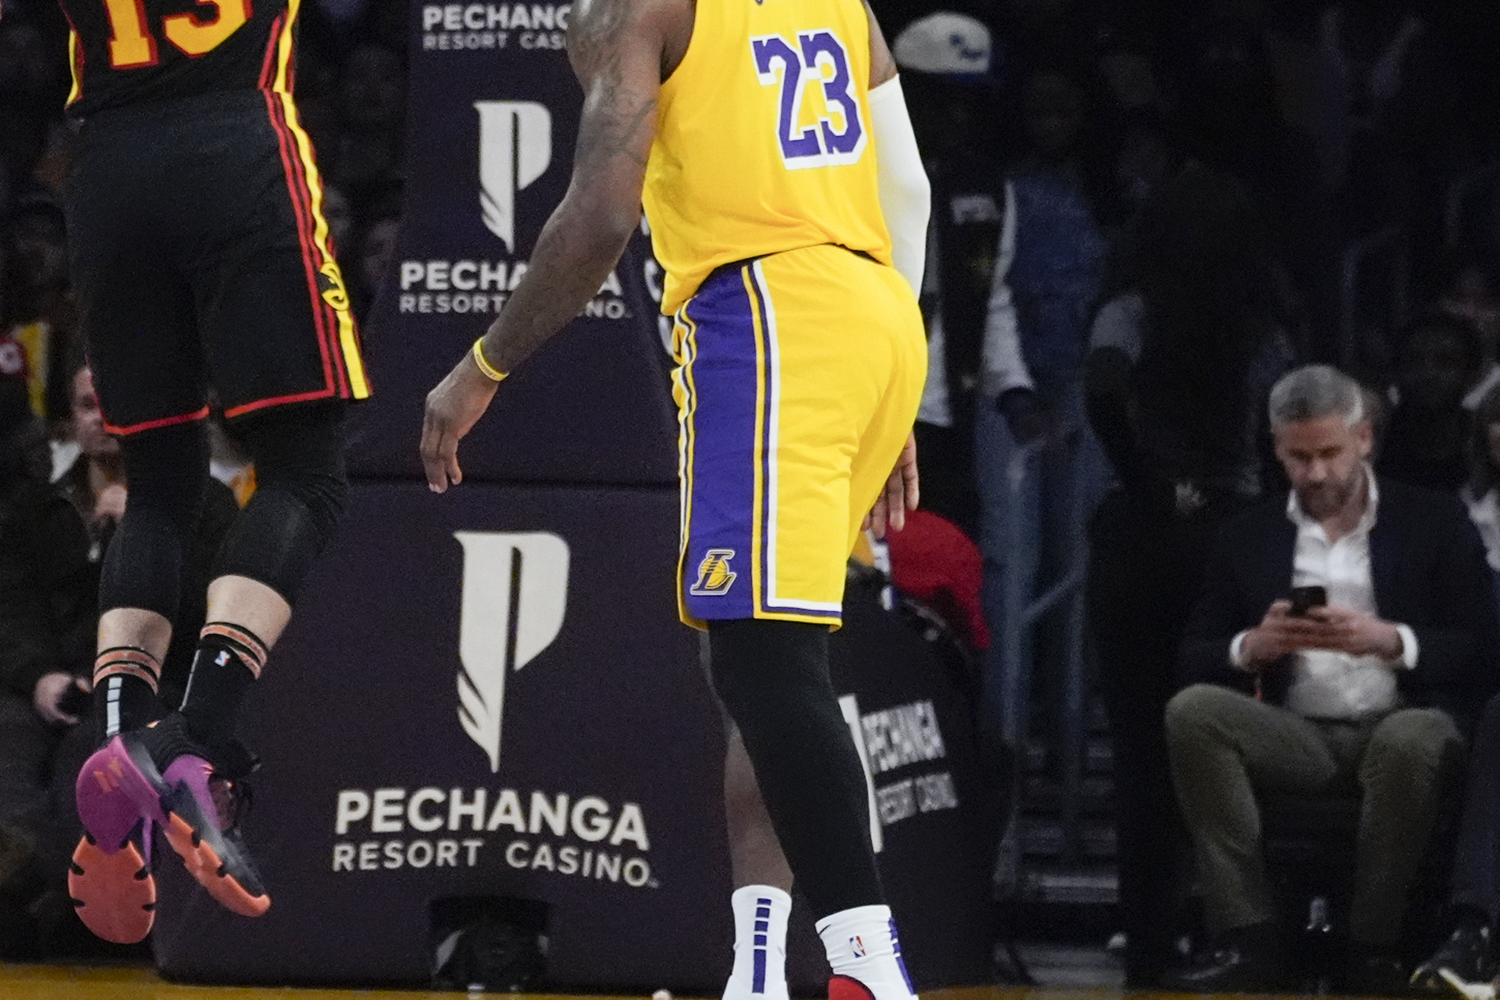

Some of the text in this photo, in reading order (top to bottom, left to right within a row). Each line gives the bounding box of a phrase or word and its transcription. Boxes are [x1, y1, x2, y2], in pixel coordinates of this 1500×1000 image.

[422, 4, 572, 31] PECHANG
[422, 31, 567, 50] RESORT CAS
[750, 27, 870, 171] 23
[400, 293, 506, 314] RESORT
[334, 787, 650, 851] PECHANGA
[332, 838, 651, 888] RESORT CASINO
